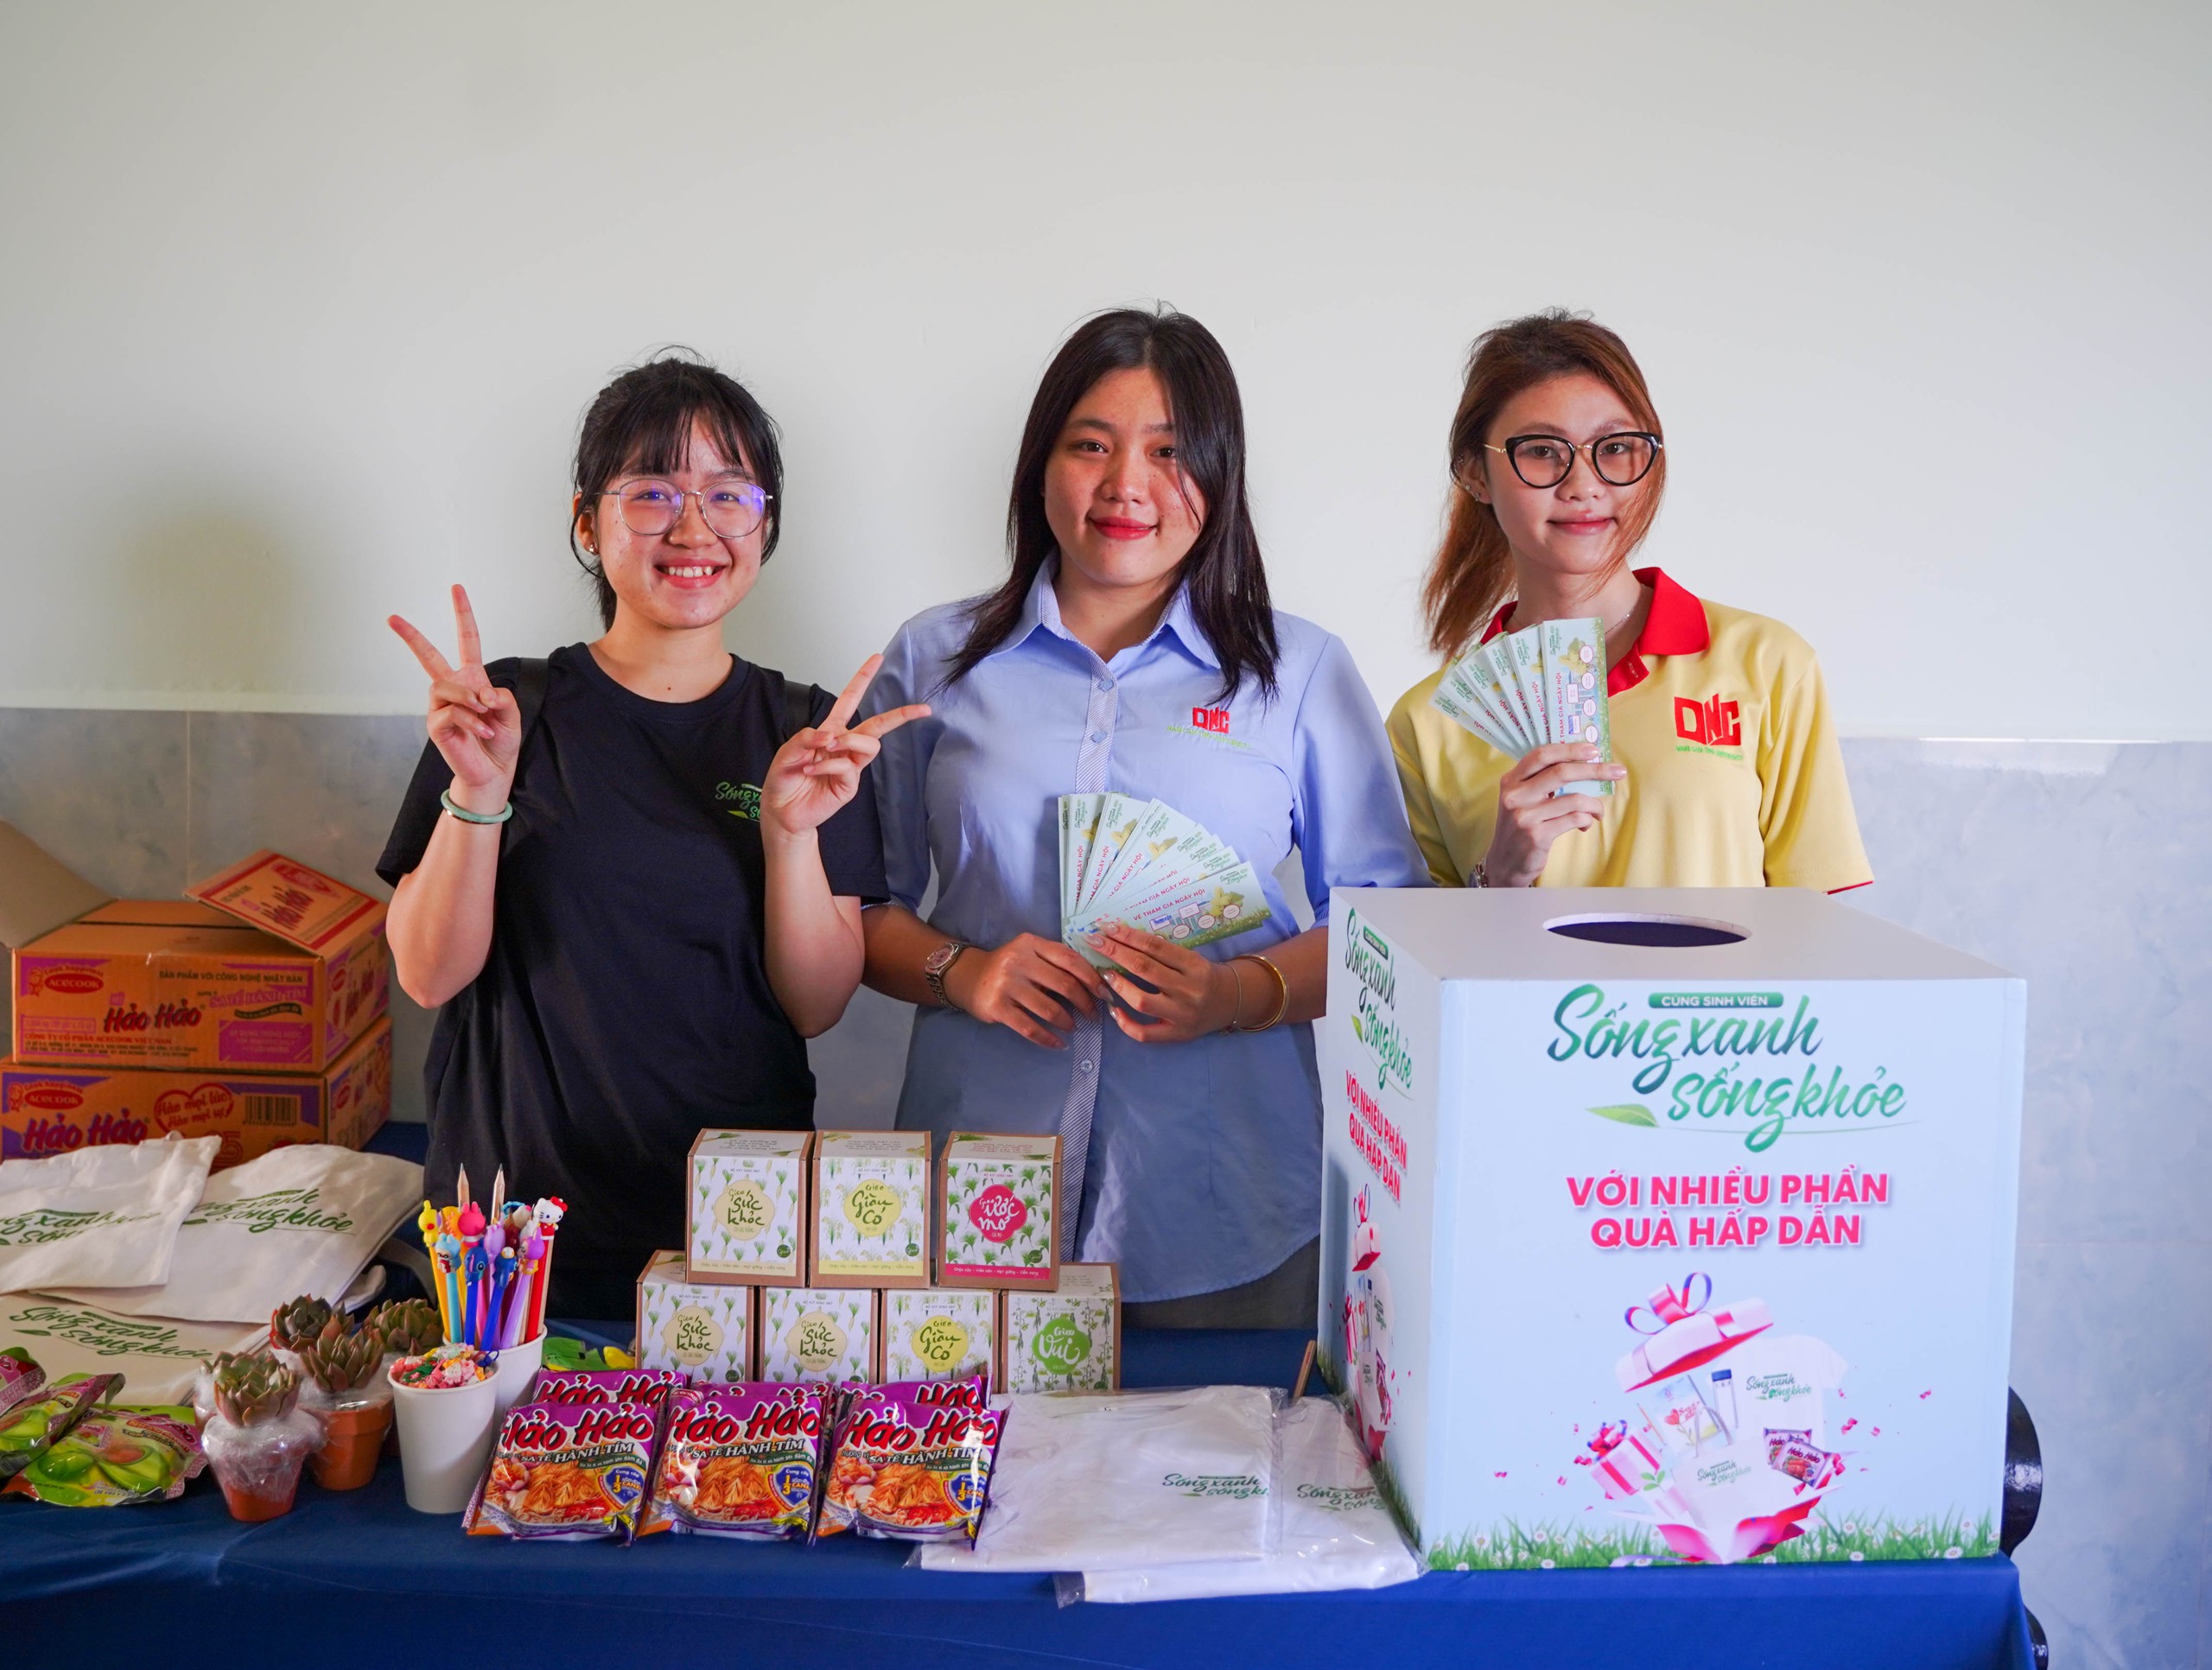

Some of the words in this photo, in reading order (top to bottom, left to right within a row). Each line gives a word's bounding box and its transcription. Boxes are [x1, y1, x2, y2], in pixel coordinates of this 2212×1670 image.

[1192, 707, 1230, 733] DNC
[1674, 693, 1741, 746] DNC
[1143, 906, 1161, 917] THAM
[104, 1003, 148, 1033] Hảo
[155, 999, 201, 1030] Hảo
[1662, 994, 1700, 1007] CÙNG
[1703, 995, 1733, 1007] SINH
[1737, 994, 1768, 1006] VIÊN
[1548, 983, 1681, 1094] Sống
[1681, 995, 1823, 1057] xanh
[1345, 1069, 1359, 1108] VỚI
[1360, 1087, 1383, 1138] NHIỀU
[1668, 1062, 1794, 1152] sống
[1792, 1063, 1907, 1118] khỏe
[23, 1112, 83, 1151] Hảo
[87, 1108, 149, 1146] Hảo
[1566, 1169, 1639, 1206] VỚI
[1650, 1165, 1770, 1205] NHIỀU
[1780, 1164, 1888, 1203] PHẦN
[1591, 1210, 1678, 1248] QUÀ
[1688, 1208, 1768, 1246] HẤP
[1777, 1204, 1860, 1244] DẪN
[1039, 1334, 1080, 1365] Vui
[533, 1375, 609, 1405] Hảo
[501, 1409, 567, 1451] Hảo
[573, 1403, 654, 1445] Hảo
[674, 1401, 740, 1444] Hảo
[745, 1396, 820, 1440] Hảo
[839, 1408, 917, 1451] Hảo
[554, 1446, 601, 1464] HÀNH
[604, 1442, 634, 1453] TÍM
[725, 1442, 771, 1457] HÀNH
[776, 1438, 805, 1451] TÍM
[902, 1448, 948, 1464] HÀNH
